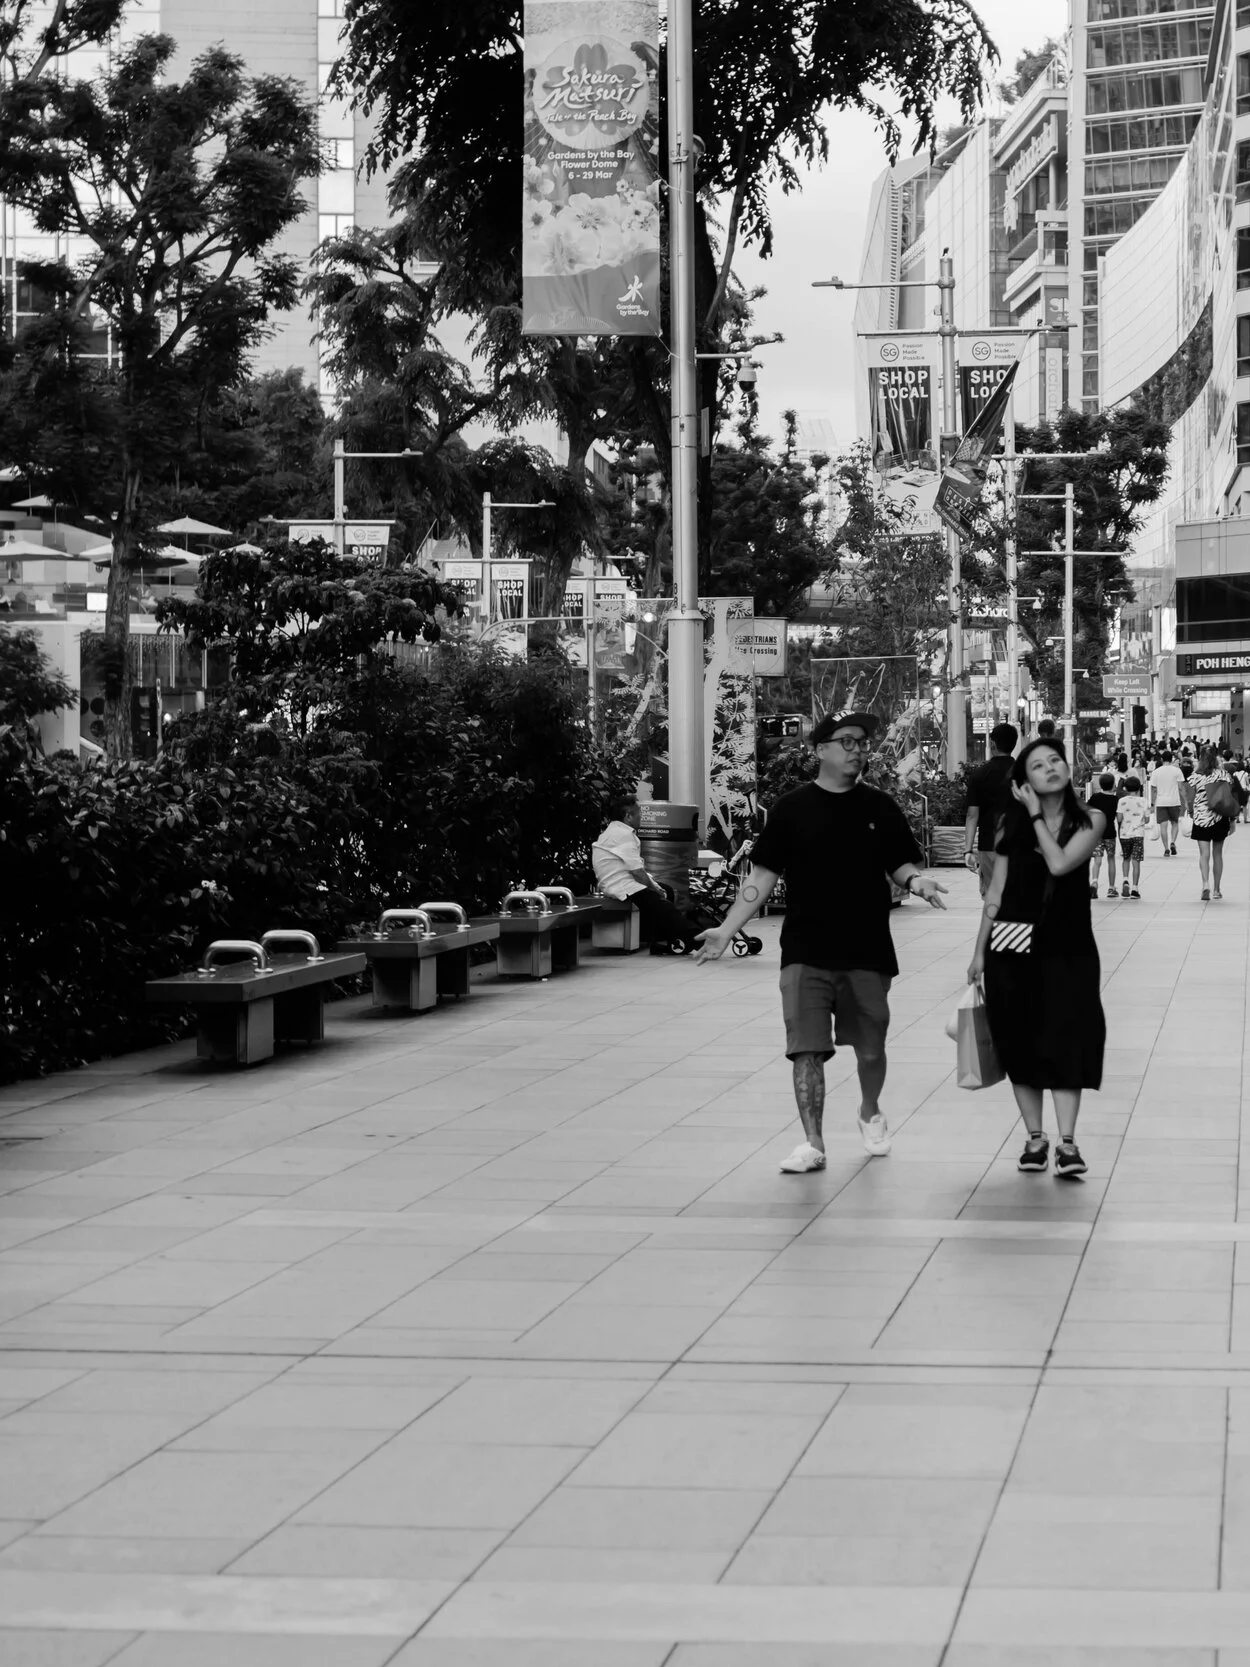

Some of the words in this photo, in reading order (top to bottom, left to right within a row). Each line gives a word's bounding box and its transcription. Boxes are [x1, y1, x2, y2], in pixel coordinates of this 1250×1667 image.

[551, 66, 624, 89] Sakura
[539, 82, 644, 109] Matsuri
[573, 112, 586, 120] the
[588, 109, 615, 120] Peach
[617, 109, 637, 124] Boy
[548, 151, 586, 160] Gardens
[587, 151, 599, 160] by
[600, 150, 615, 158] the
[617, 150, 635, 160] Bay
[561, 160, 590, 169] Flower
[591, 160, 619, 168] Dome
[568, 171, 575, 179] 6
[582, 171, 594, 179] 29
[595, 170, 613, 179] Mar
[883, 348, 898, 357] SG
[974, 347, 989, 356] SG
[879, 370, 928, 385] SHOP
[879, 386, 929, 399] LOCAL
[352, 545, 382, 556] SHOP
[497, 581, 523, 589] SHOP
[750, 646, 778, 656] Crossing
[1196, 657, 1220, 670] POH
[1114, 678, 1128, 686] Keep
[1123, 687, 1149, 695] Crossing
